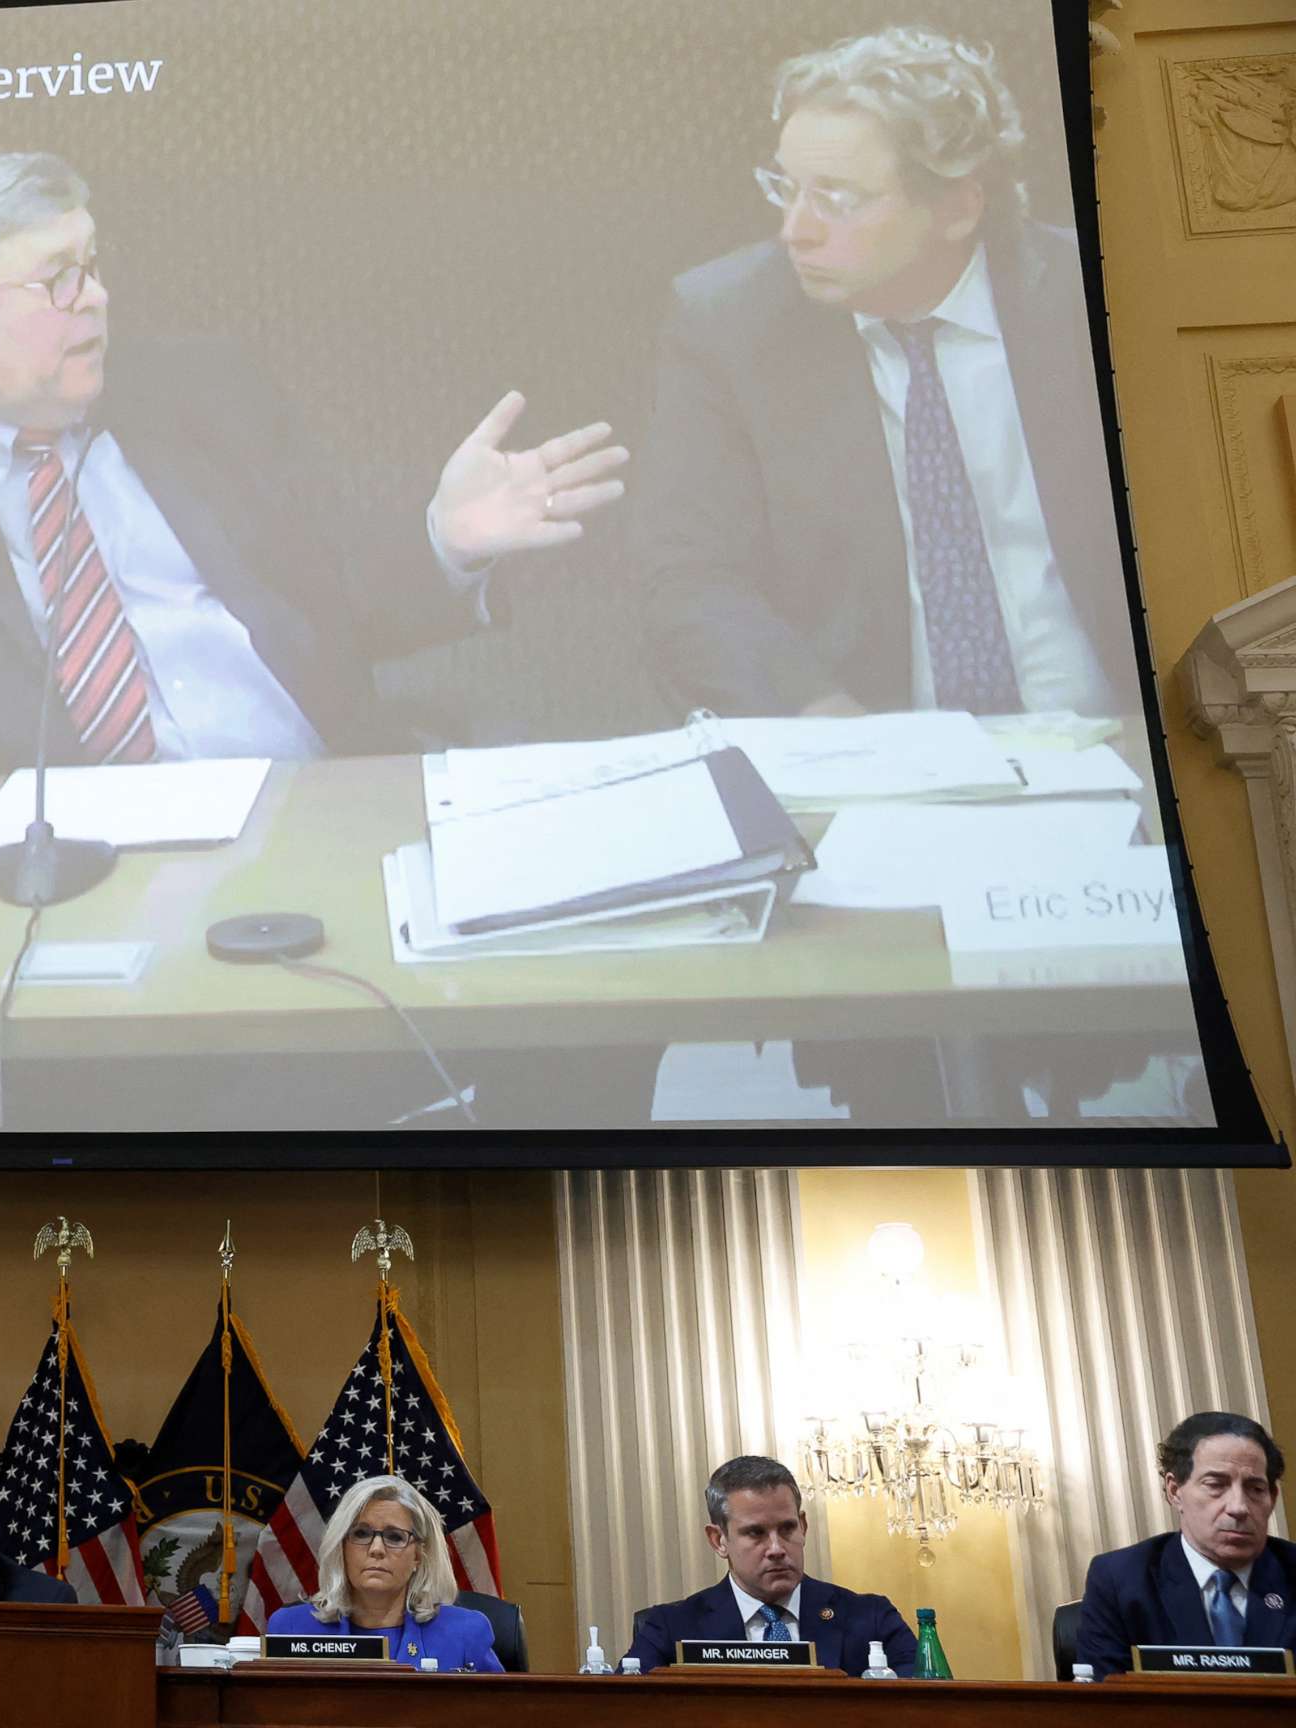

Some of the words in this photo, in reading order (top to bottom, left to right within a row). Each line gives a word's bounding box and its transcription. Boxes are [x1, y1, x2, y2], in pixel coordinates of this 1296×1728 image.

[985, 884, 1068, 922] Eric
[1082, 879, 1175, 923] Sny
[290, 1642, 310, 1653] MS.
[312, 1642, 357, 1653] CHENEY
[702, 1648, 724, 1659] MR.
[726, 1648, 789, 1660] KINZINGER
[1172, 1654, 1198, 1667] MR.
[1200, 1654, 1251, 1668] RASKIN
